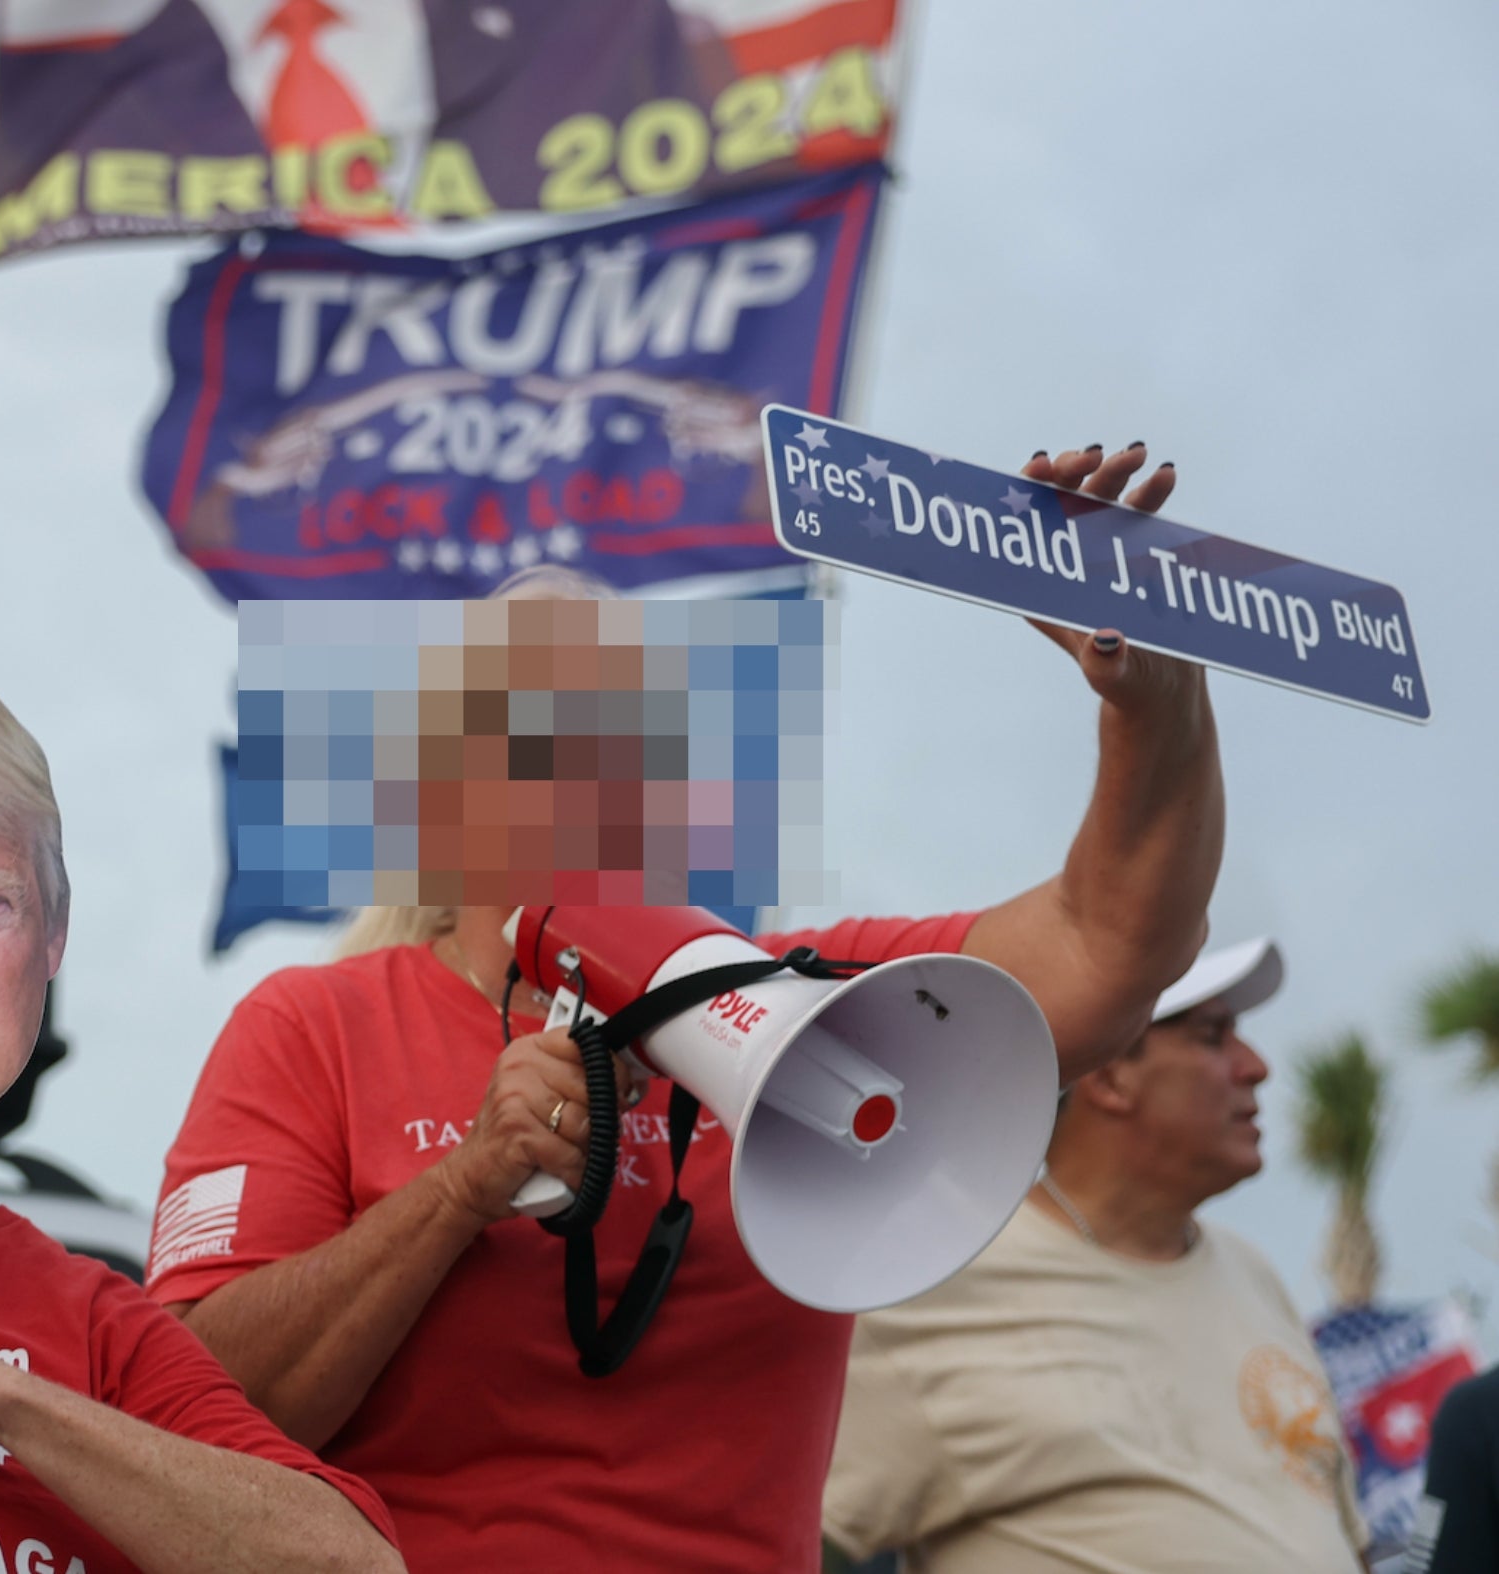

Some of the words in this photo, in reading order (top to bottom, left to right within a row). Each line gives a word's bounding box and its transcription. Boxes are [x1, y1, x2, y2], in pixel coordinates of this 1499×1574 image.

[538, 45, 884, 212] 2024
[254, 232, 816, 396] TRUMP
[388, 392, 590, 480] 2024
[298, 482, 450, 550] LOCK
[527, 467, 685, 530] LOAD
[794, 510, 822, 537] 45
[784, 444, 876, 507] Pres.
[887, 475, 1086, 583] Donald
[1110, 537, 1148, 600] J.
[1150, 547, 1320, 660] Trump
[1333, 599, 1407, 656] Blvd
[1392, 674, 1415, 701] 47
[404, 1118, 473, 1151] TA
